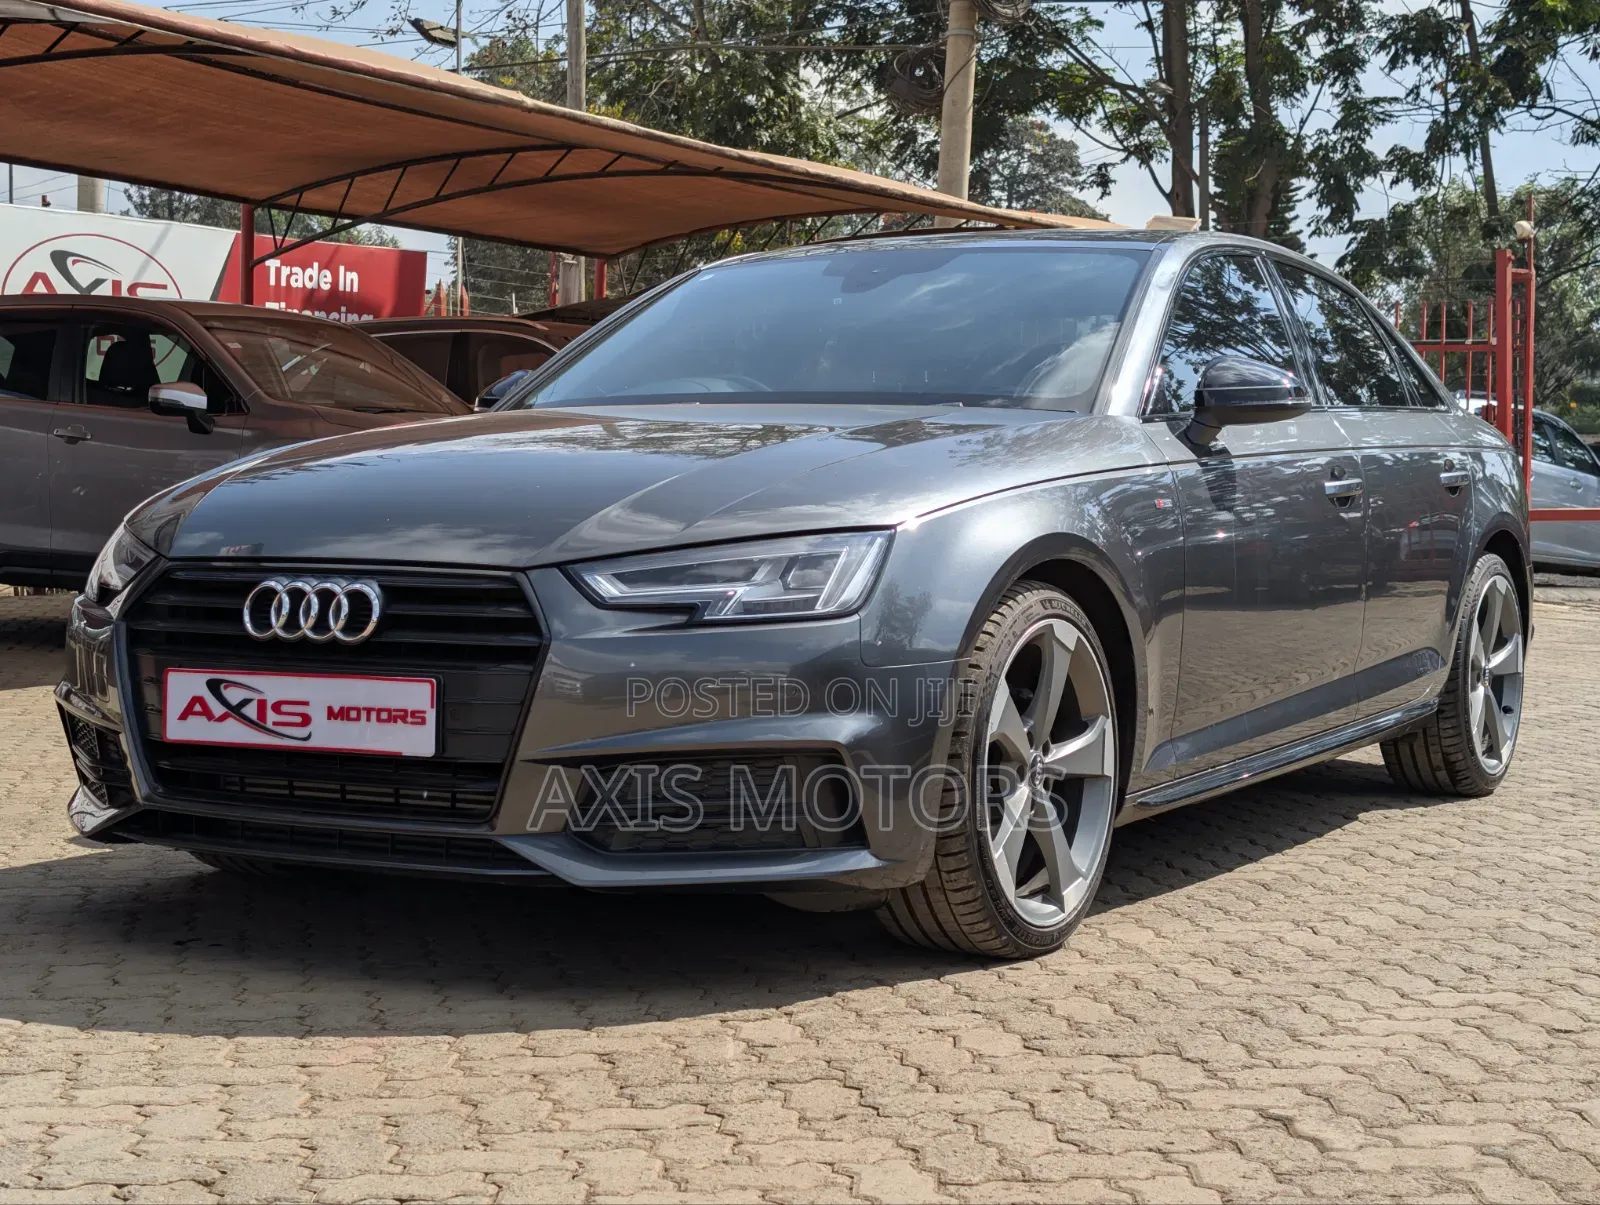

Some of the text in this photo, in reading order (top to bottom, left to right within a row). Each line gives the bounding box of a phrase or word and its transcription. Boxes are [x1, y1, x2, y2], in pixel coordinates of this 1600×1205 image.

[265, 259, 359, 292] Trade In
[176, 678, 427, 741] AXIS MOTORS
